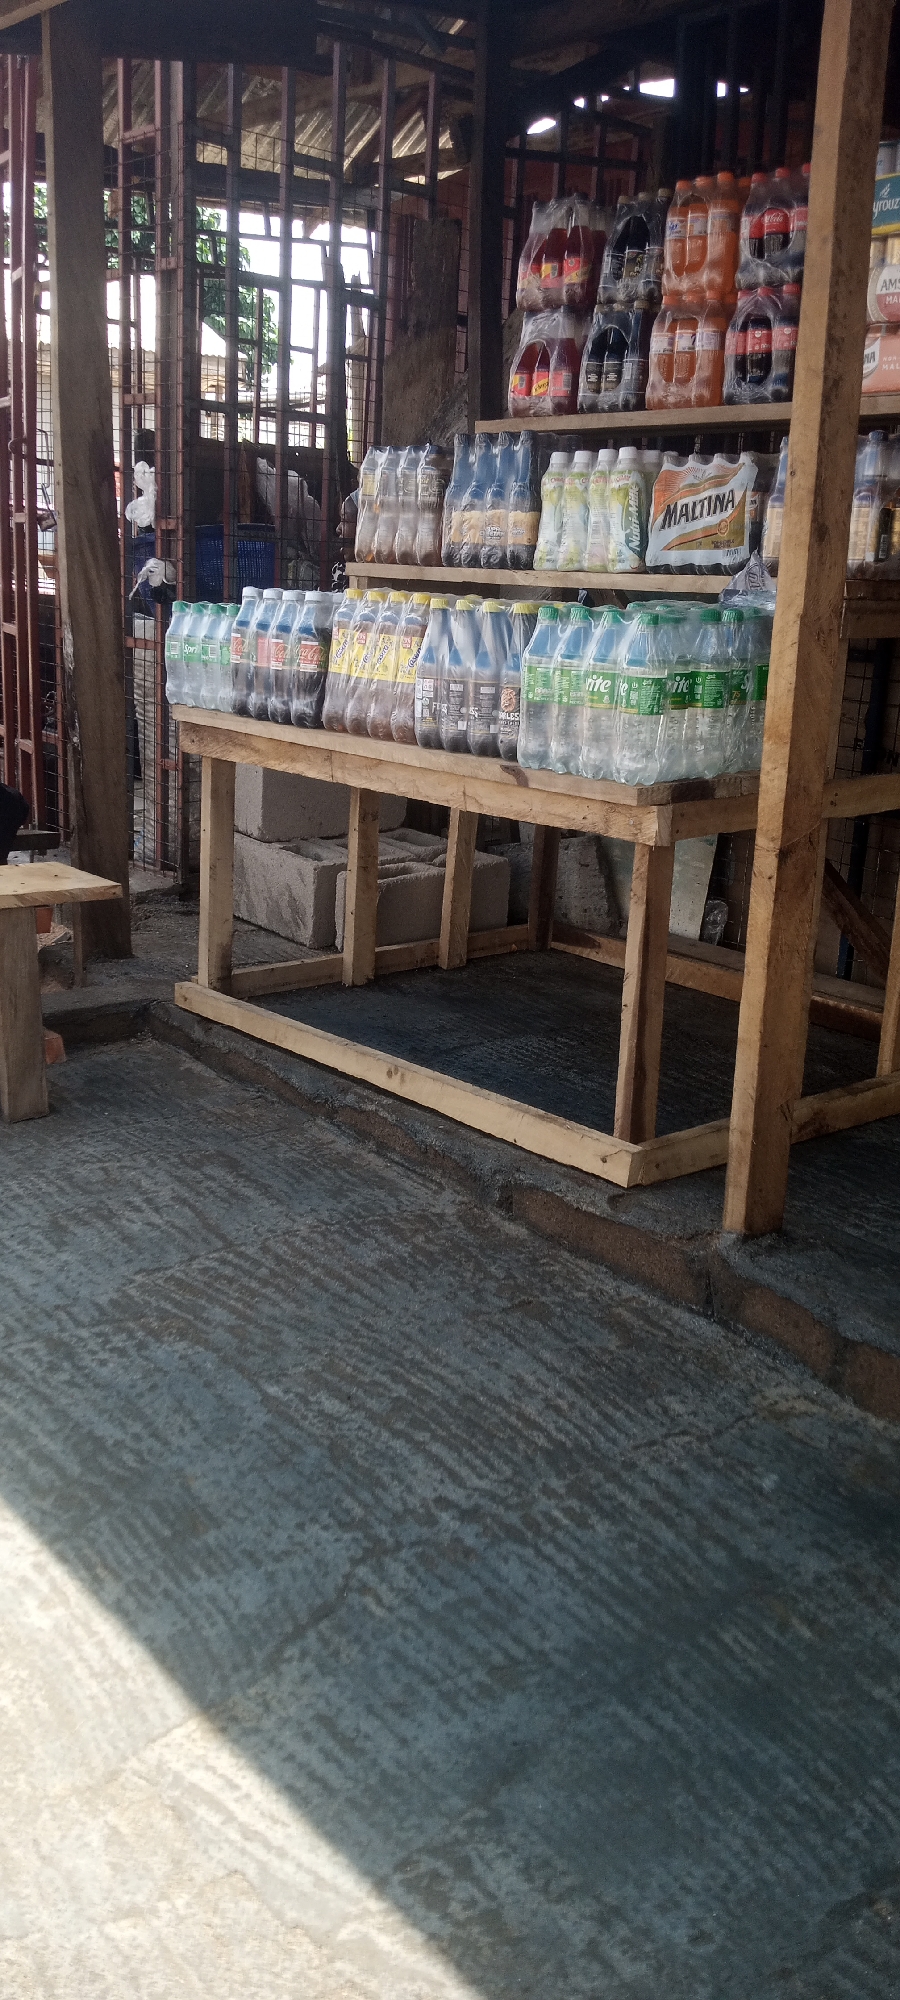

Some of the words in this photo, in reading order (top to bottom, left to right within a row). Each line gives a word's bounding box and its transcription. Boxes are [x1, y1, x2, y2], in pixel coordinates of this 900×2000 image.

[872, 198, 900, 220] yrouz
[628, 483, 641, 552] Nutri-Milk
[659, 488, 736, 532] MALTINA
[586, 674, 612, 693] rite
